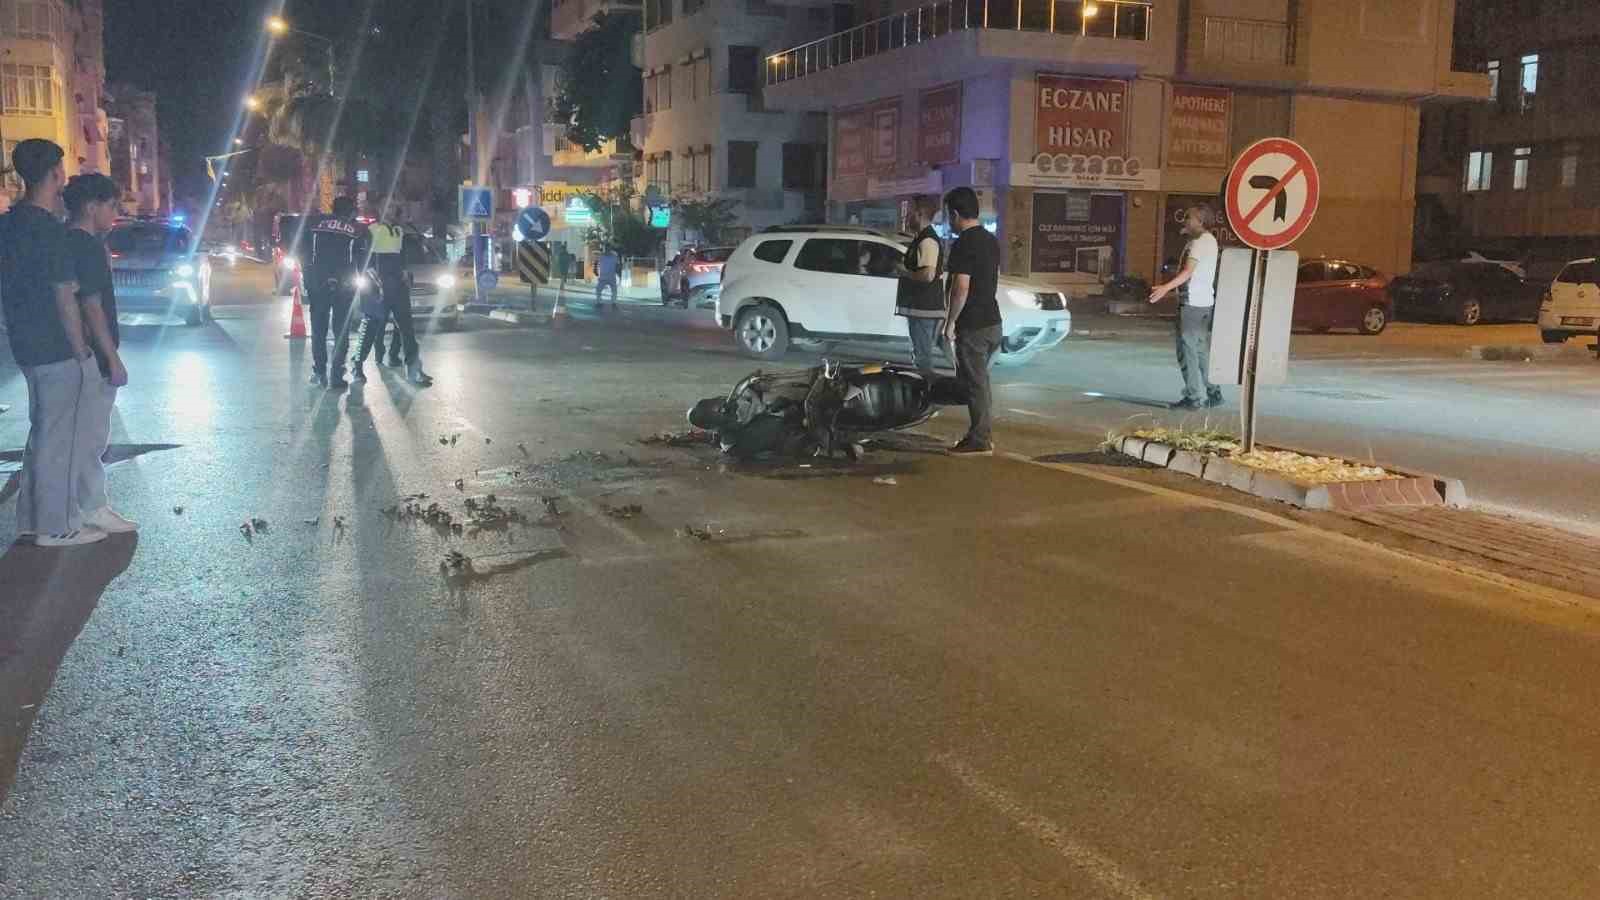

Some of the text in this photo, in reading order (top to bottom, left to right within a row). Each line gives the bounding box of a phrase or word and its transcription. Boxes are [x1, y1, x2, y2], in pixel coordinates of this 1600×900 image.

[1040, 87, 1121, 112] ECZANE
[1048, 120, 1113, 149] HİSAR
[1036, 153, 1141, 178] eczane
